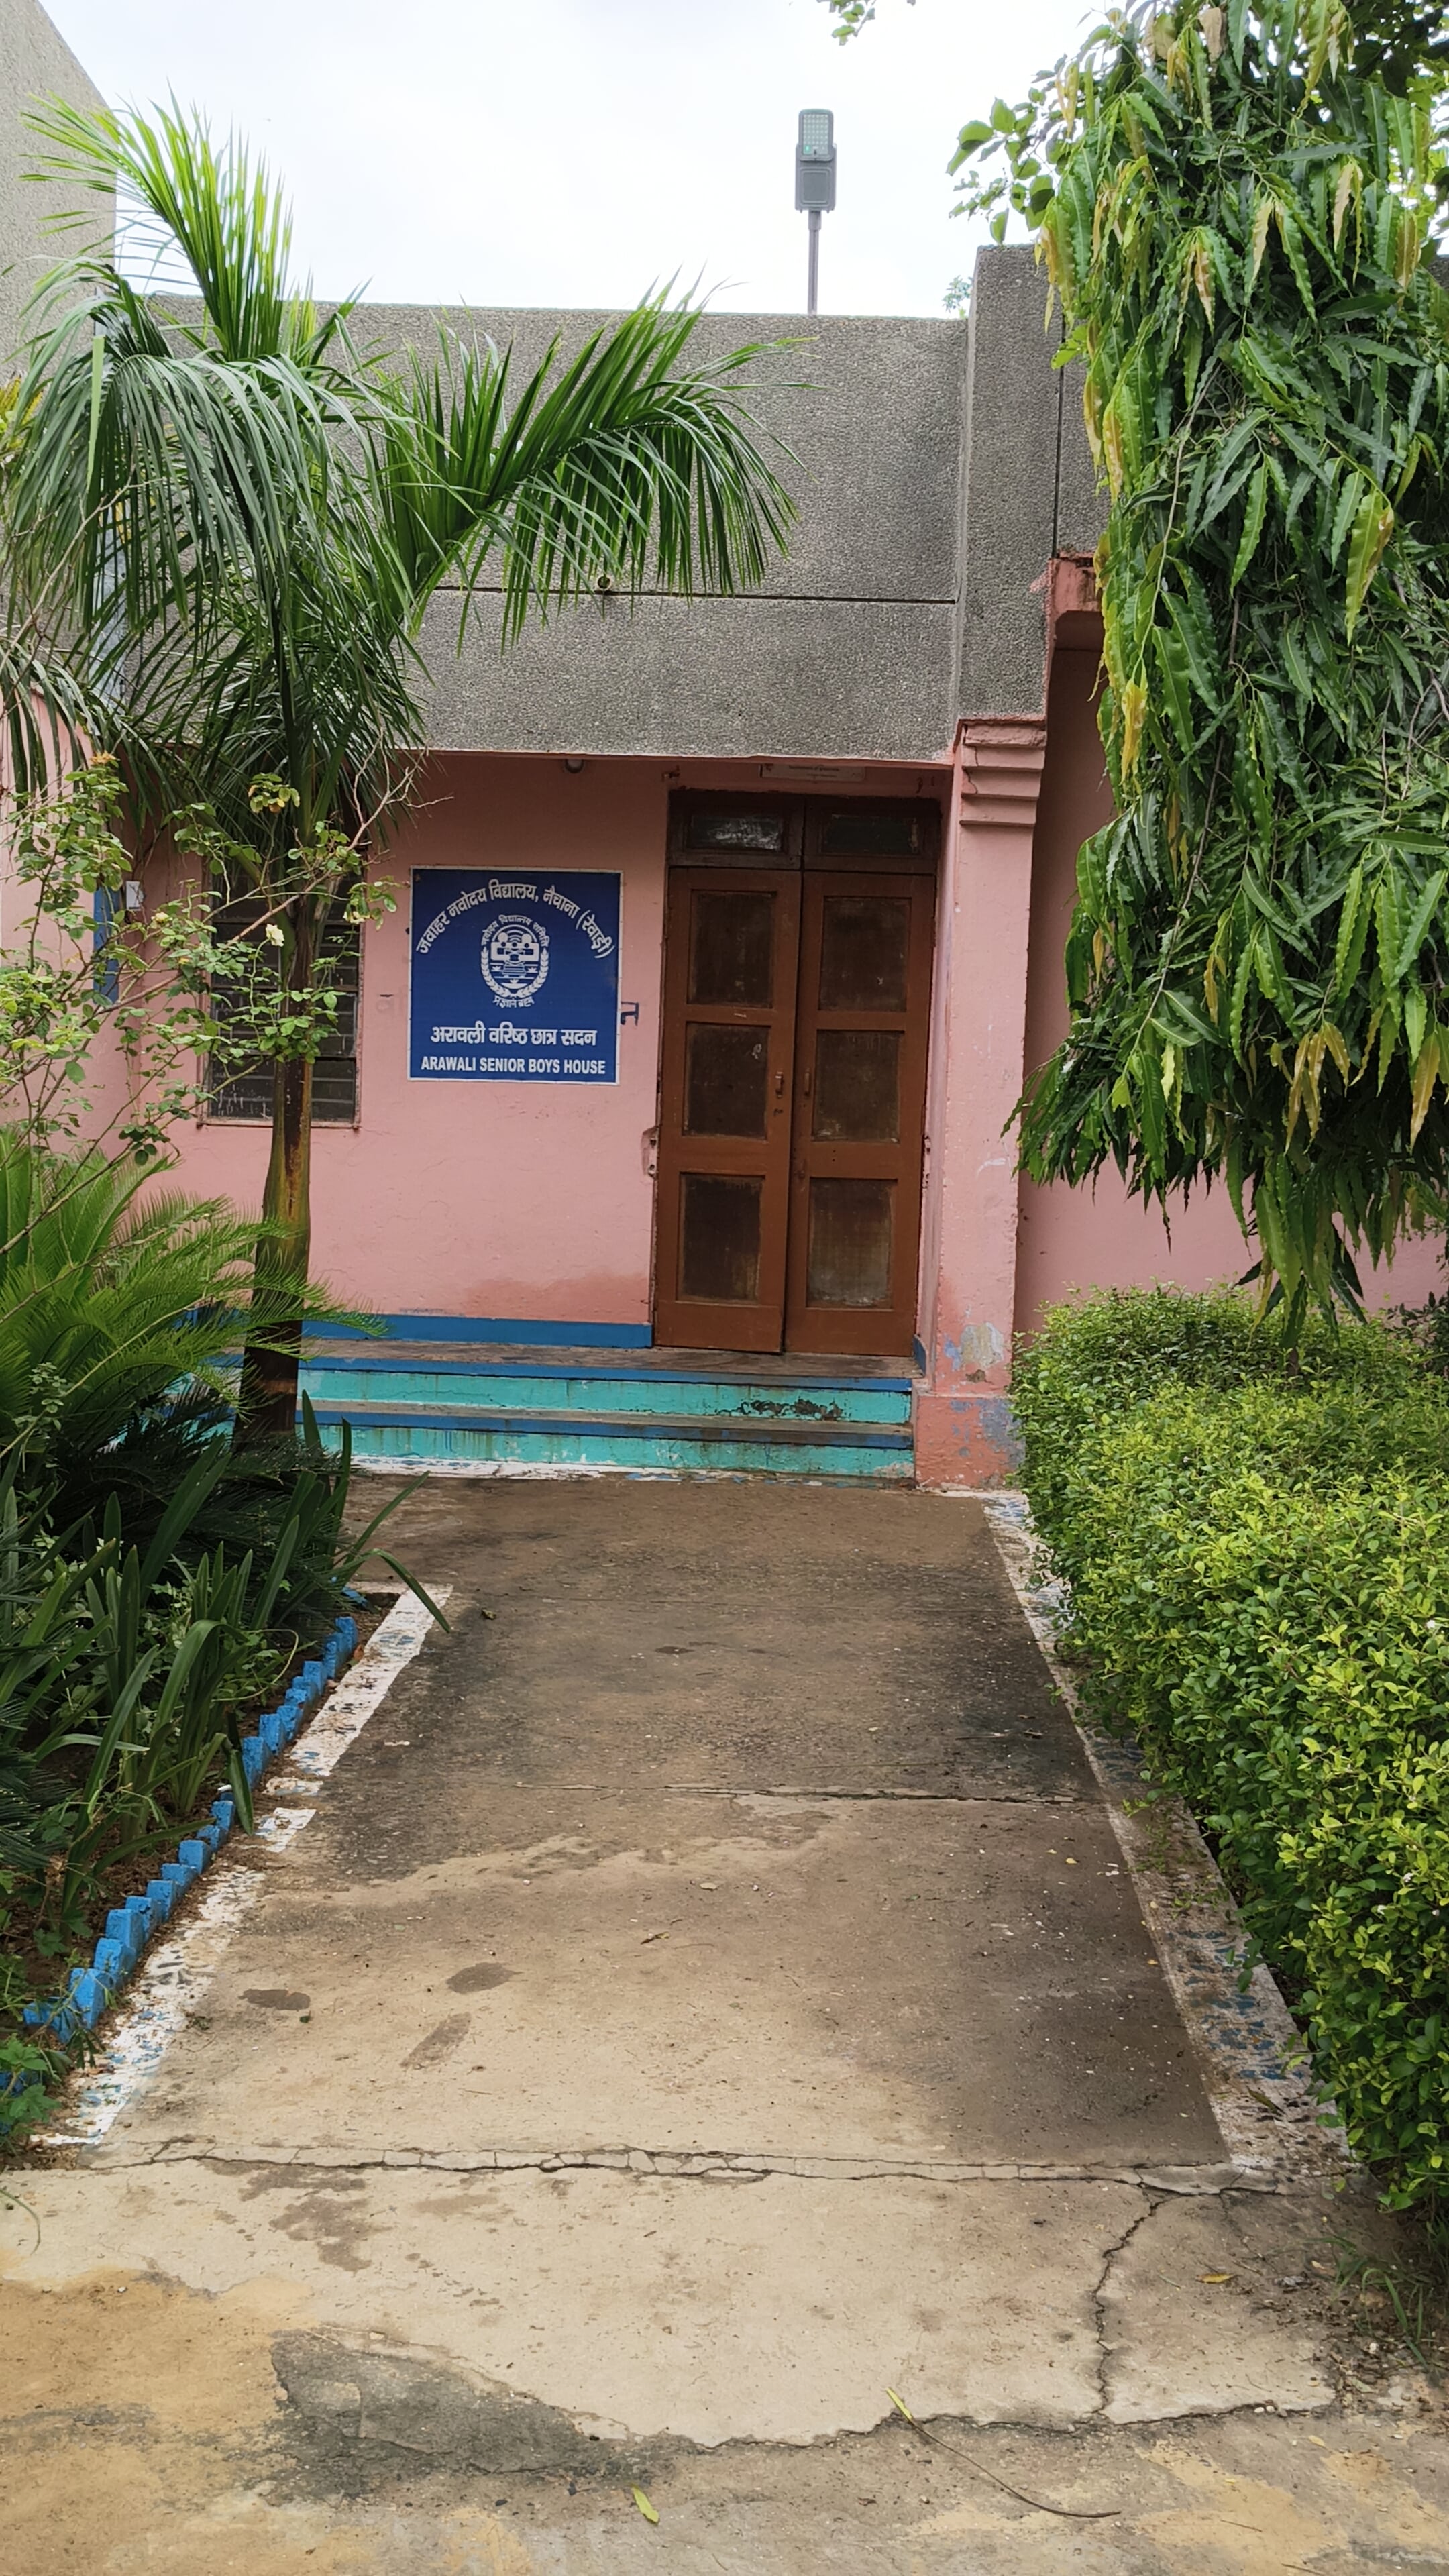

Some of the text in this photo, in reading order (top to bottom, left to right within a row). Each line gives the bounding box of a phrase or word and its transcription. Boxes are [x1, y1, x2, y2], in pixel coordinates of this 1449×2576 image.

[416, 910, 451, 953] जवाहर
[446, 890, 488, 917] नवोदय
[488, 878, 539, 902] विद्यालय,
[543, 884, 580, 919] नैचाना
[430, 1020, 597, 1046] अरावली वरिष्ठ छात्र सदन
[421, 1056, 606, 1075] ARAWALI SENIOR BOYS HOUSE
